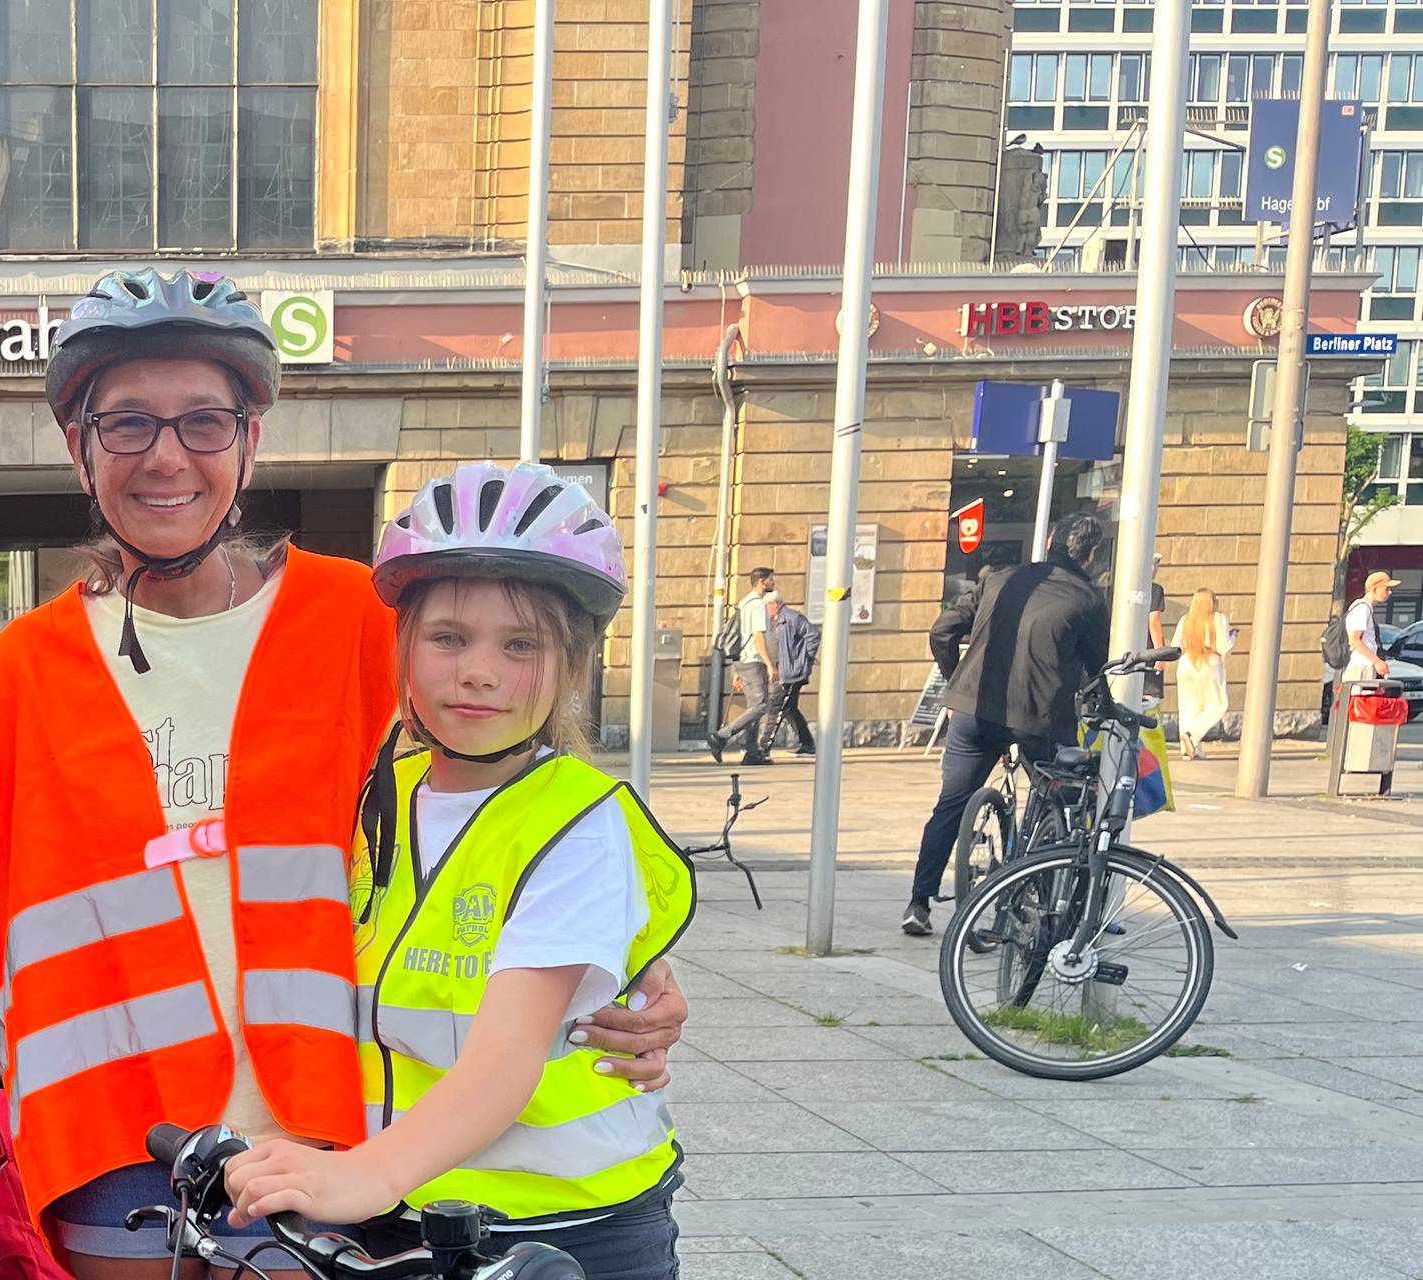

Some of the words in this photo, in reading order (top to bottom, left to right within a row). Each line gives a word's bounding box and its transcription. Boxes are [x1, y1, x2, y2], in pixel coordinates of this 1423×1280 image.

[279, 301, 318, 352] S
[961, 301, 1050, 337] HBB
[1312, 336, 1361, 351] Berliner
[1363, 337, 1393, 351] Platz
[403, 946, 451, 977] HERE
[455, 954, 478, 979] TO
